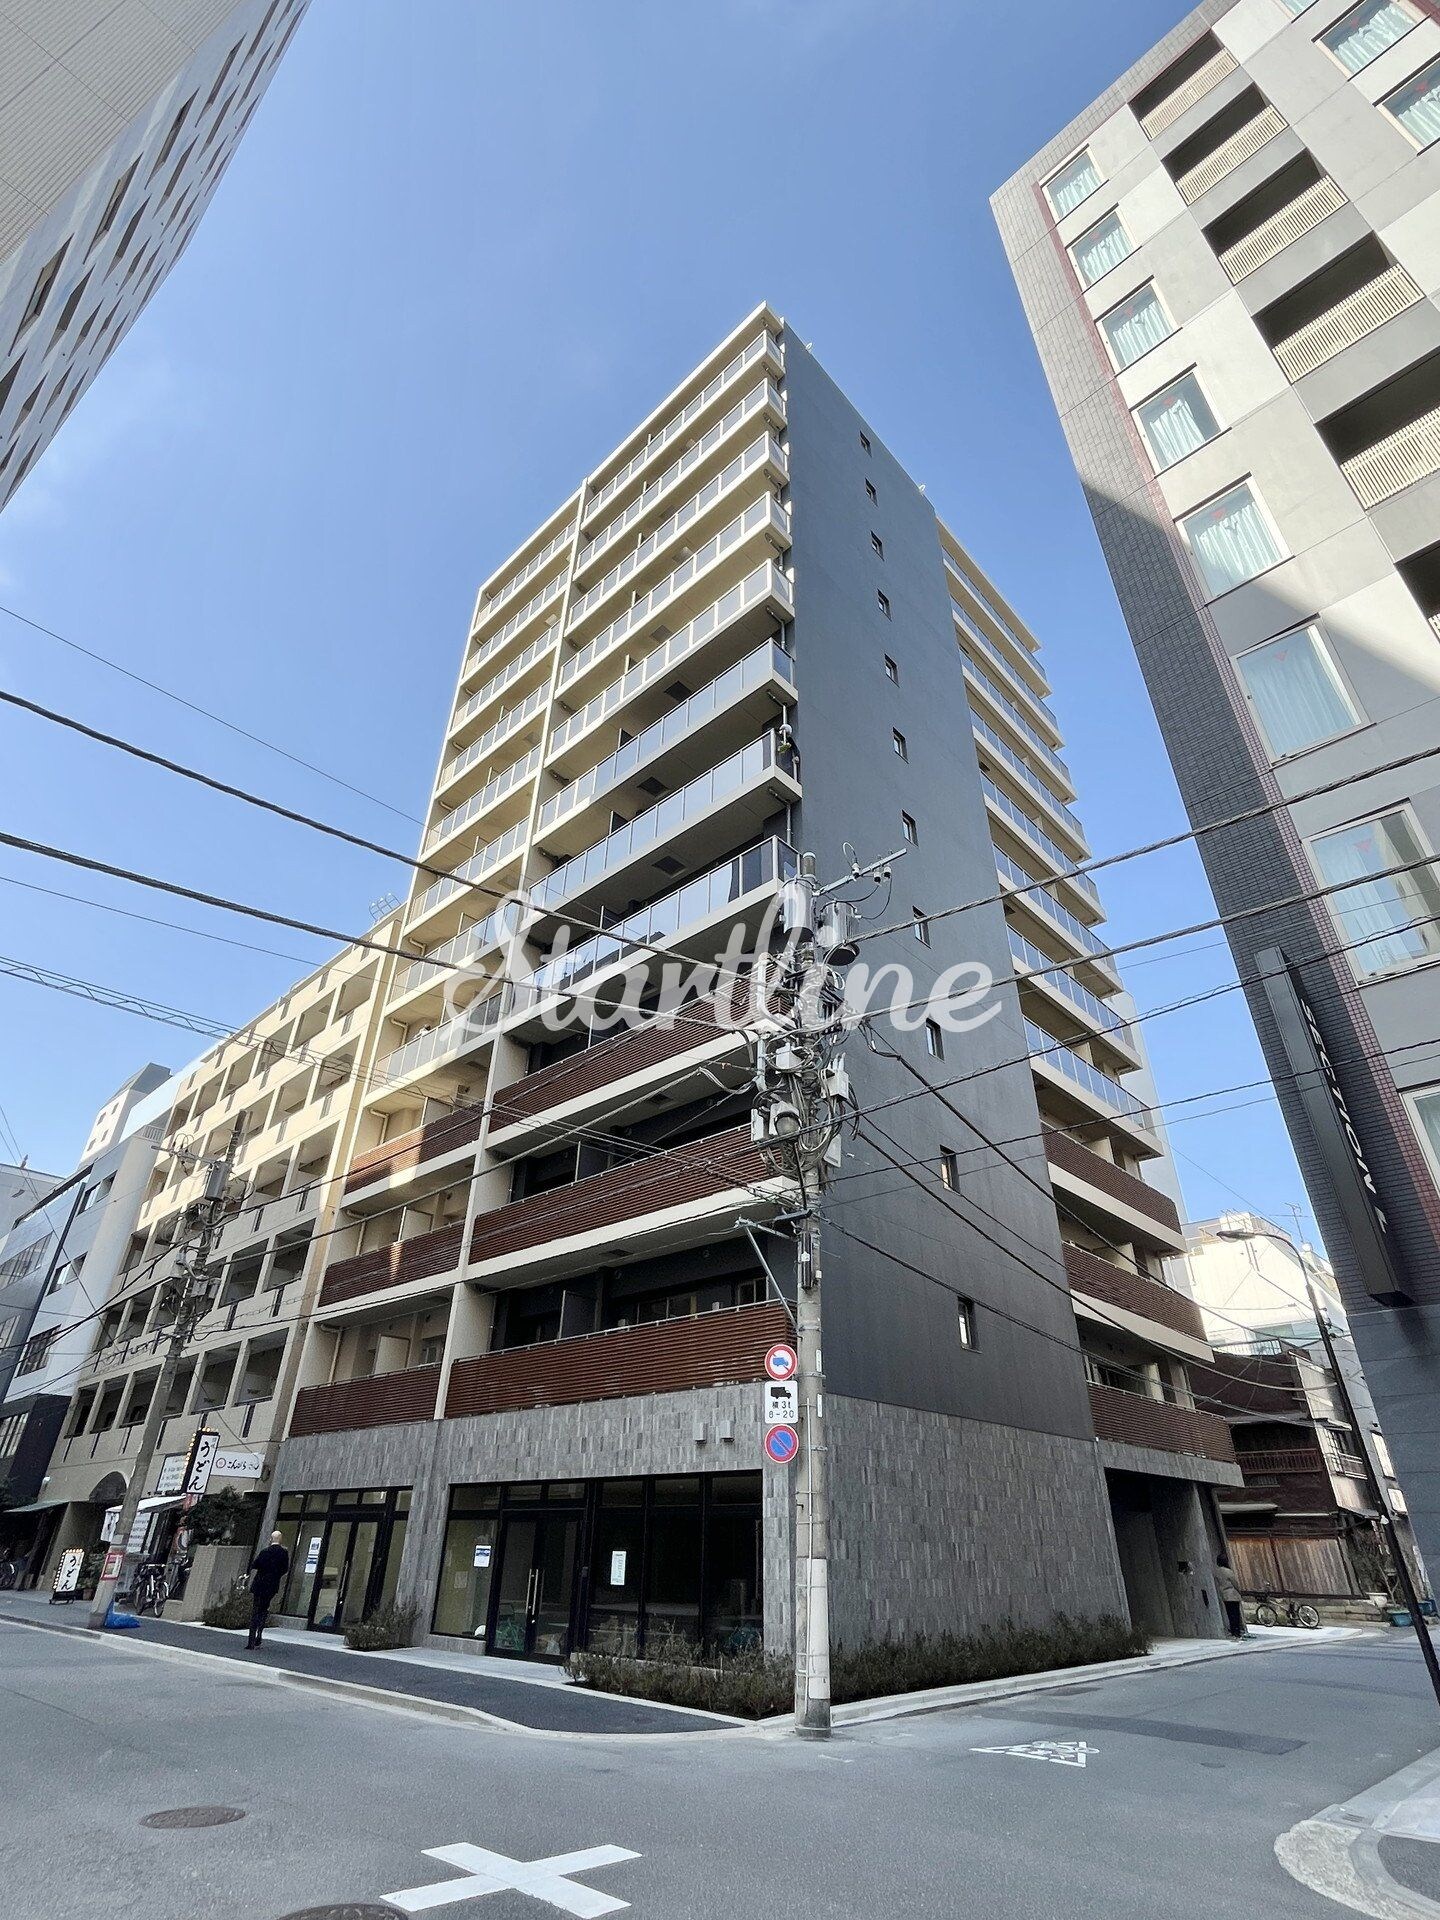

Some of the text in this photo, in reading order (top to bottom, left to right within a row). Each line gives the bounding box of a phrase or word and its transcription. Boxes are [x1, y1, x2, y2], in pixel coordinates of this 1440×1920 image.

[1300, 998, 1377, 1195] SECTION
[188, 1440, 211, 1491] うどん
[61, 1555, 77, 1591] うどん
